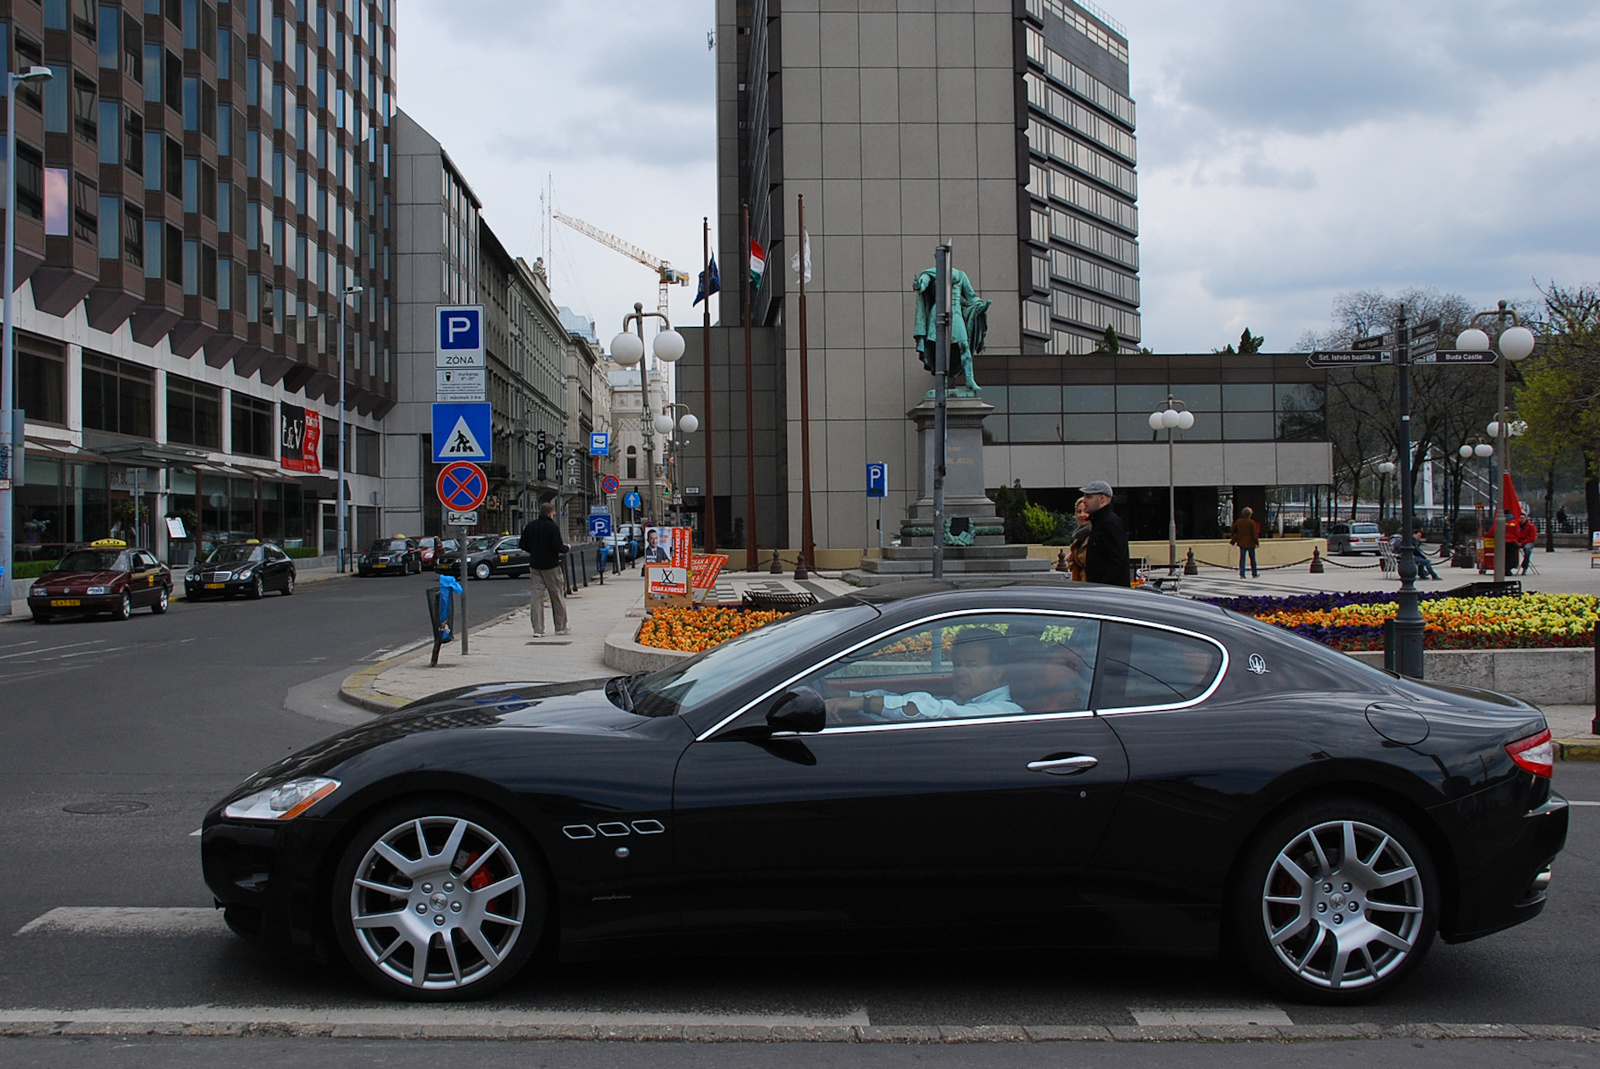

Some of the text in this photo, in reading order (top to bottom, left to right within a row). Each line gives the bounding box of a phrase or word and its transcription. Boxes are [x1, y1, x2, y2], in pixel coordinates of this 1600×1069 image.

[448, 317, 471, 343] P
[446, 355, 475, 365] ZÓNA
[870, 468, 881, 489] P
[594, 521, 605, 534] P
